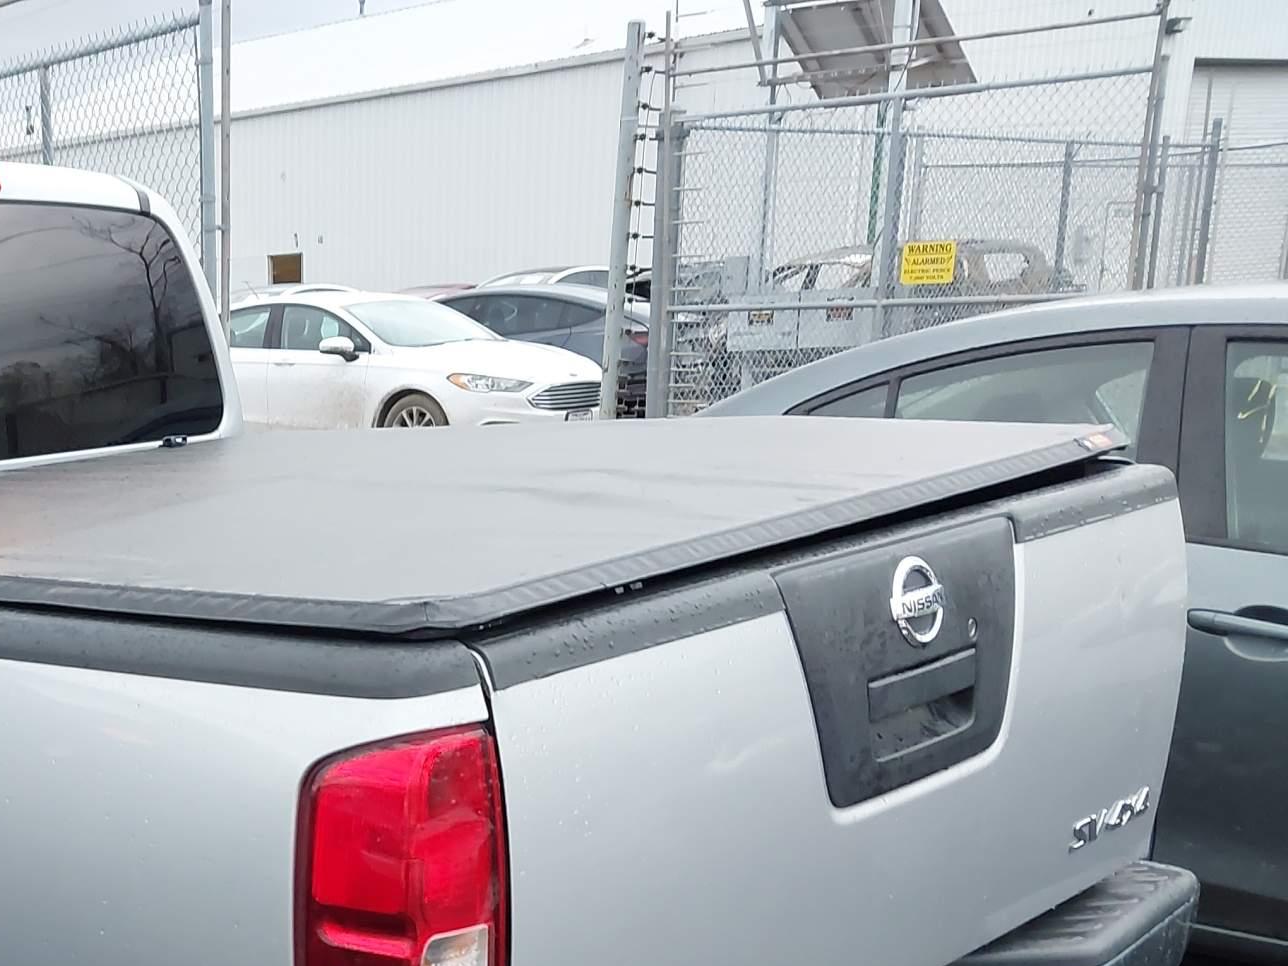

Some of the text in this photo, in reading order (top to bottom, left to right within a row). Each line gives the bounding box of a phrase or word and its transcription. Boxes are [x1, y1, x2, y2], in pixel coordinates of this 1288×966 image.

[908, 243, 952, 254] WARNING
[911, 257, 946, 265] ALARMED
[901, 590, 944, 615] NISSAN
